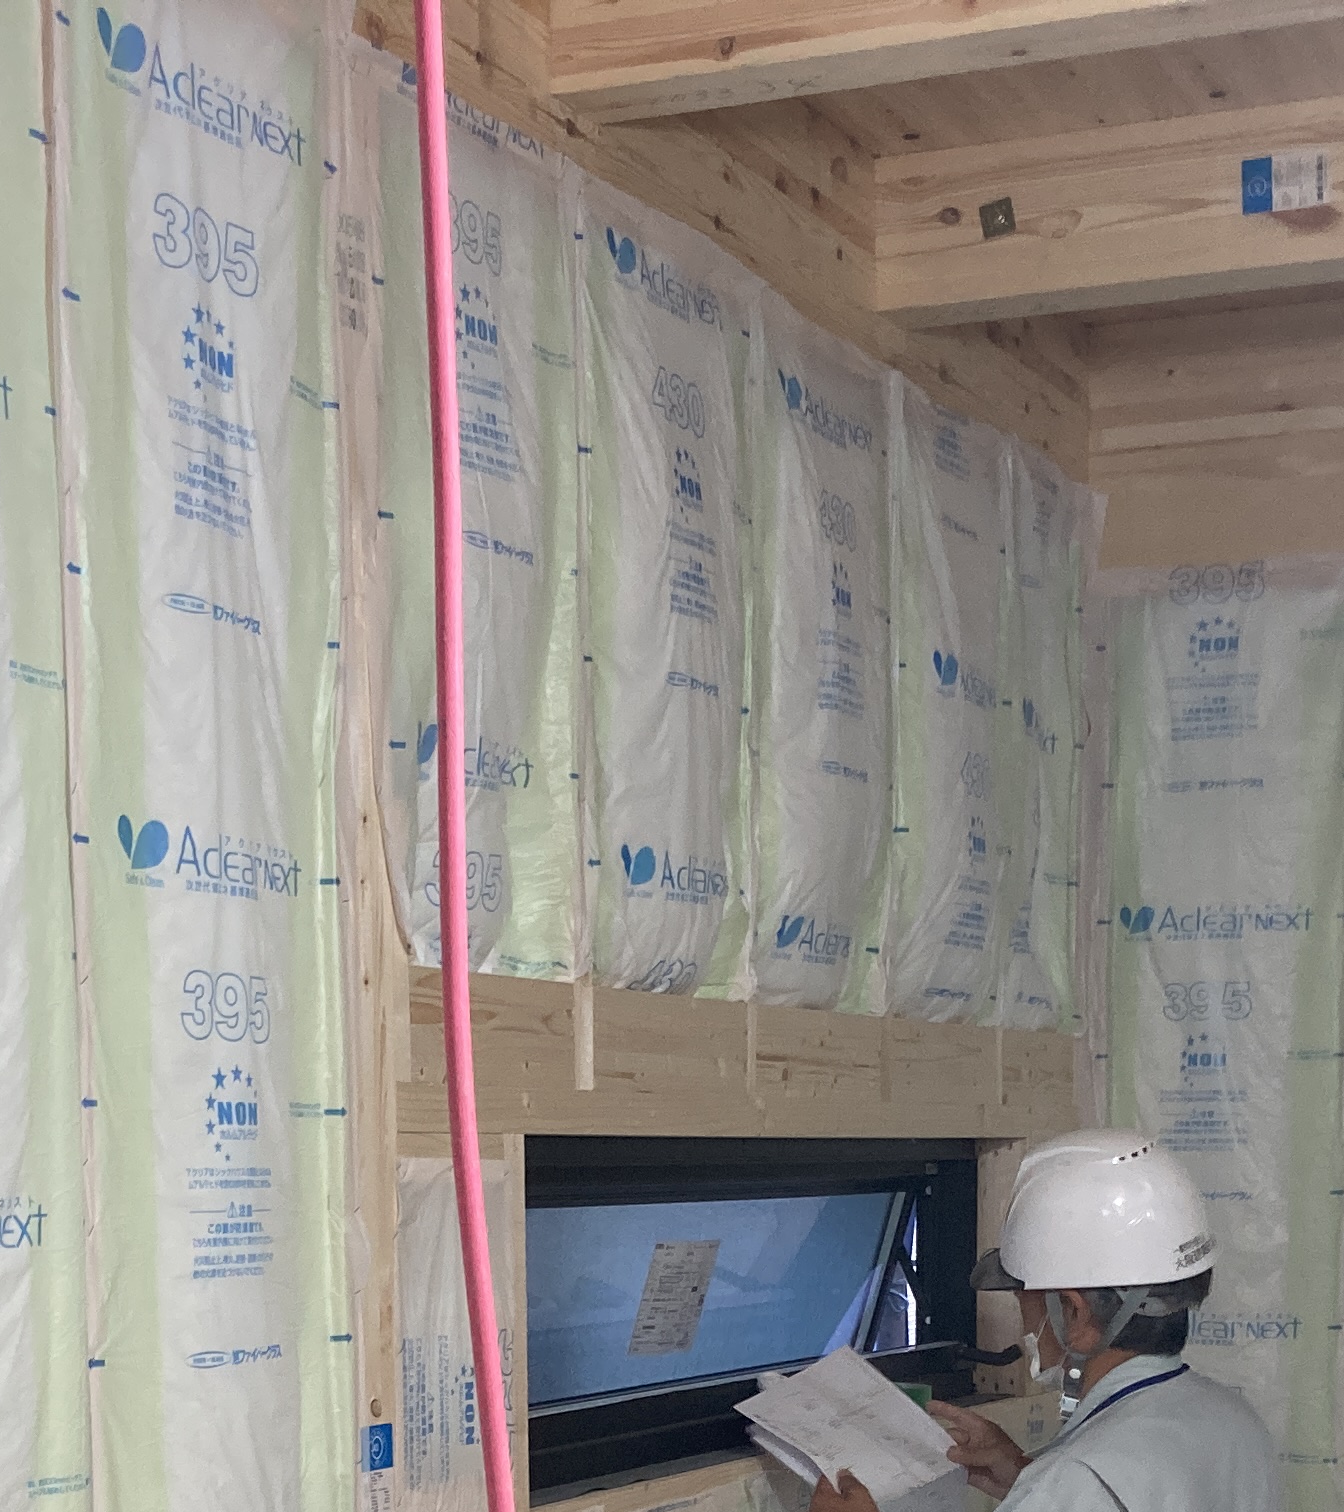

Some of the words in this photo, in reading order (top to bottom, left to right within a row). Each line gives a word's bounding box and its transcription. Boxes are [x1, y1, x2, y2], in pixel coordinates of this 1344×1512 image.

[152, 193, 259, 297] 395
[464, 313, 499, 346] NON
[652, 366, 706, 439] 430
[1169, 560, 1265, 602] 395
[1197, 633, 1240, 654] NON
[181, 970, 270, 1044] 395
[1162, 981, 1253, 1021] 395
[216, 1101, 259, 1127] NON
[1188, 1314, 1303, 1341] learNext
[464, 1381, 475, 1446] NON
